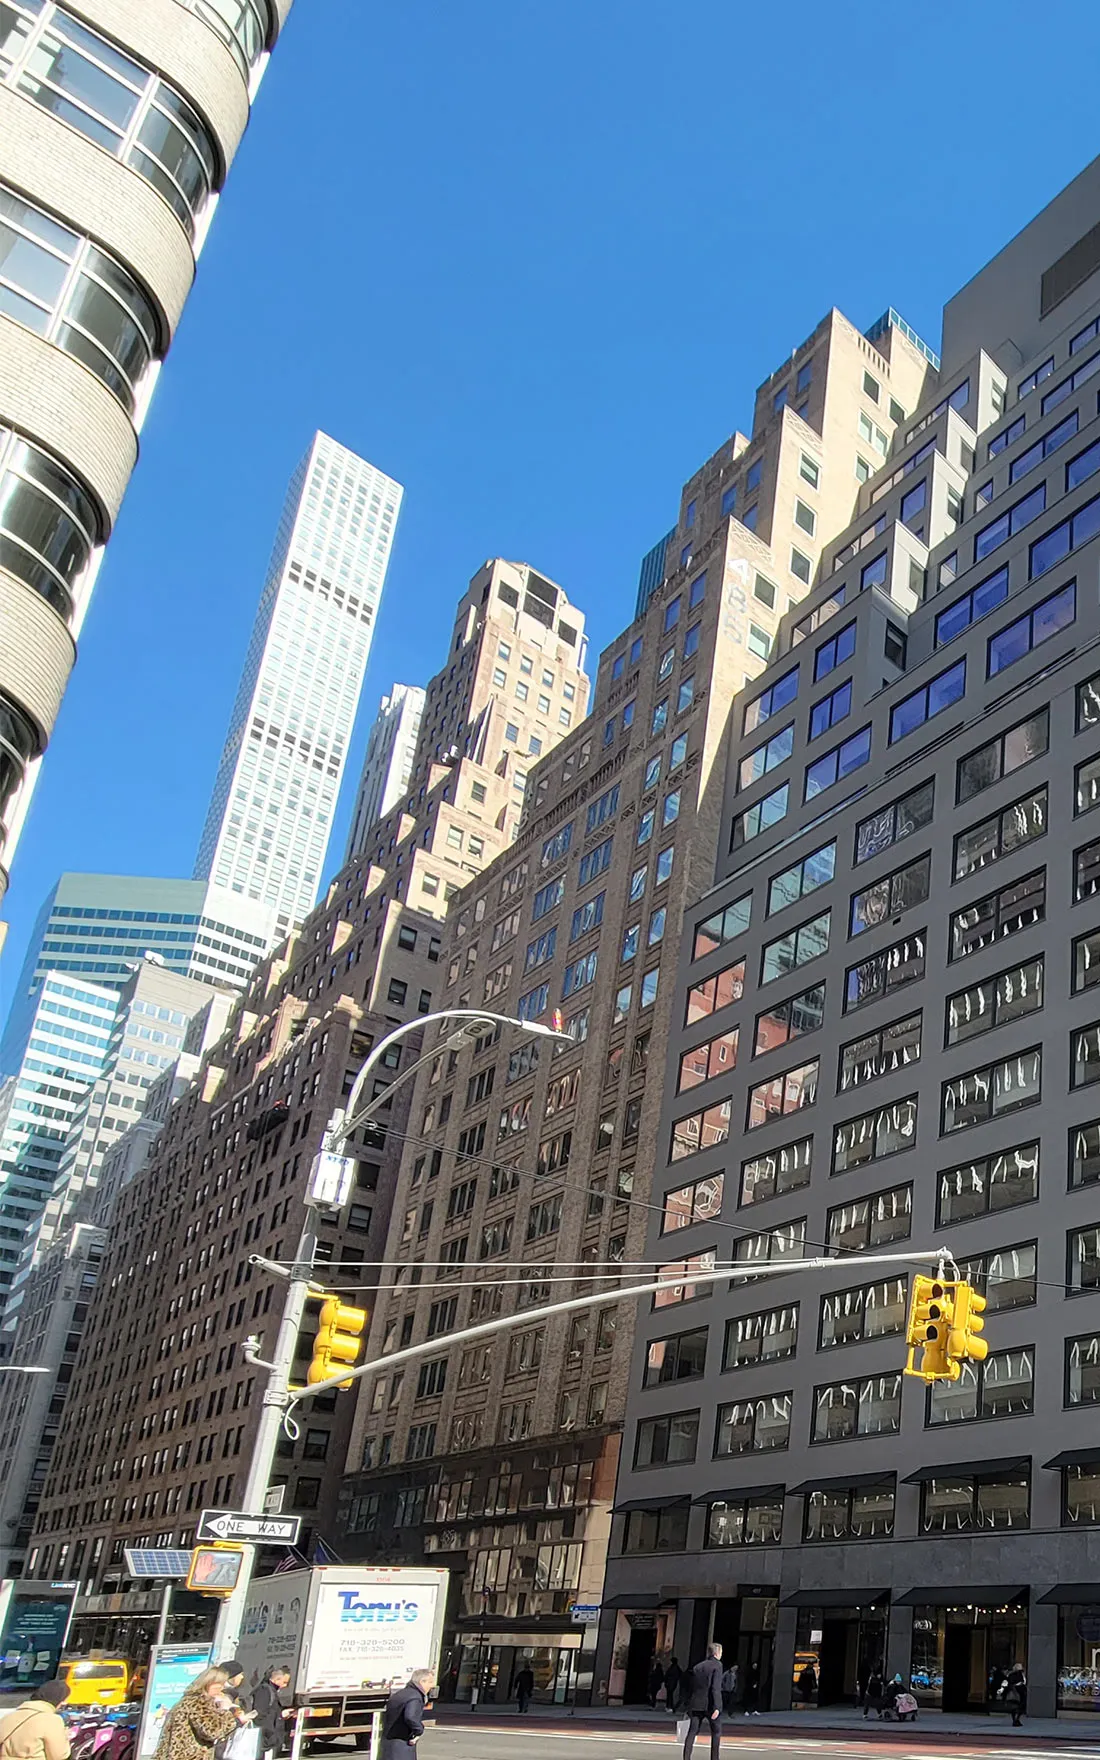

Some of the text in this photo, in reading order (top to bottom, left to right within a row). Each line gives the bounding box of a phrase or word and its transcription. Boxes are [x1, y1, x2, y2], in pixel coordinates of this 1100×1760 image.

[217, 1520, 286, 1535] ONE WAY
[338, 1591, 419, 1623] Tony's
